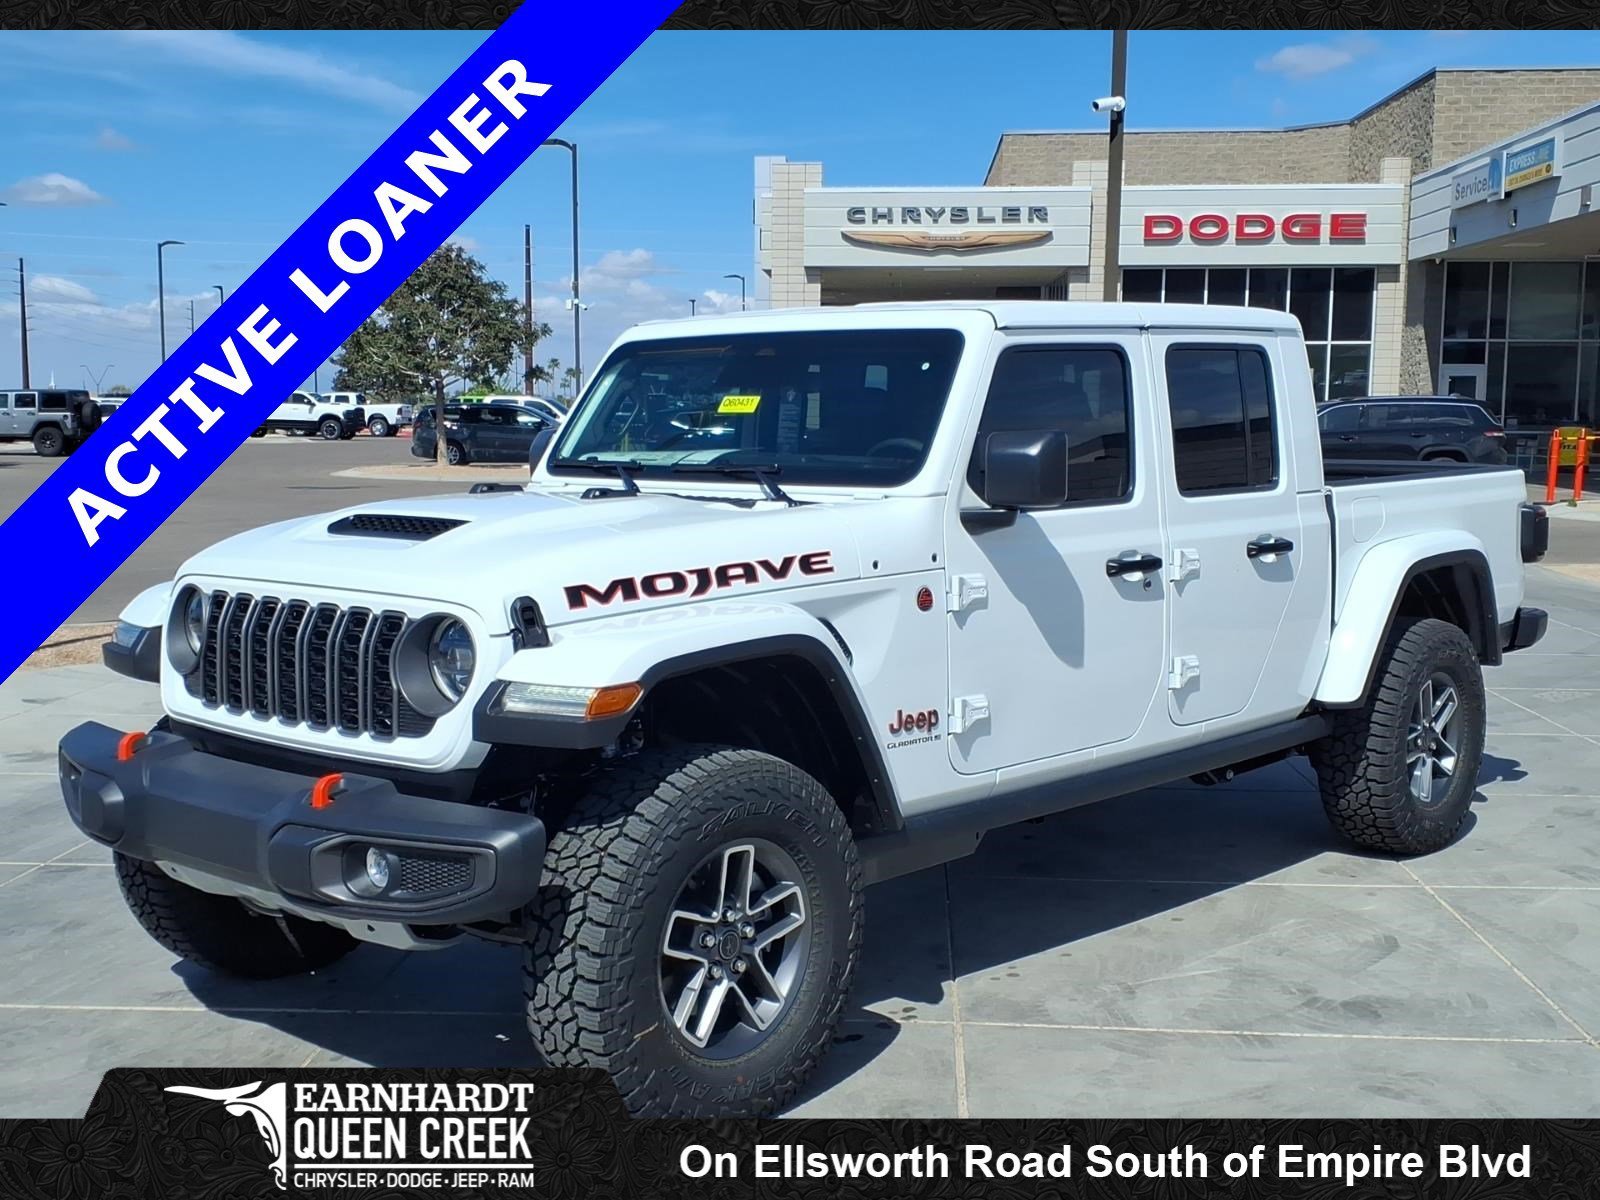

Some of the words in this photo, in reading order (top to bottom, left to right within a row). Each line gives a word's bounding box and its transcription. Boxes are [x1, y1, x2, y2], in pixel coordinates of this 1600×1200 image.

[847, 206, 1049, 225] CHRYSLER
[1143, 213, 1367, 242] DODGE
[563, 550, 835, 610] MOJAVE
[889, 709, 940, 735] Jeep
[887, 736, 934, 750] GLADIATOR
